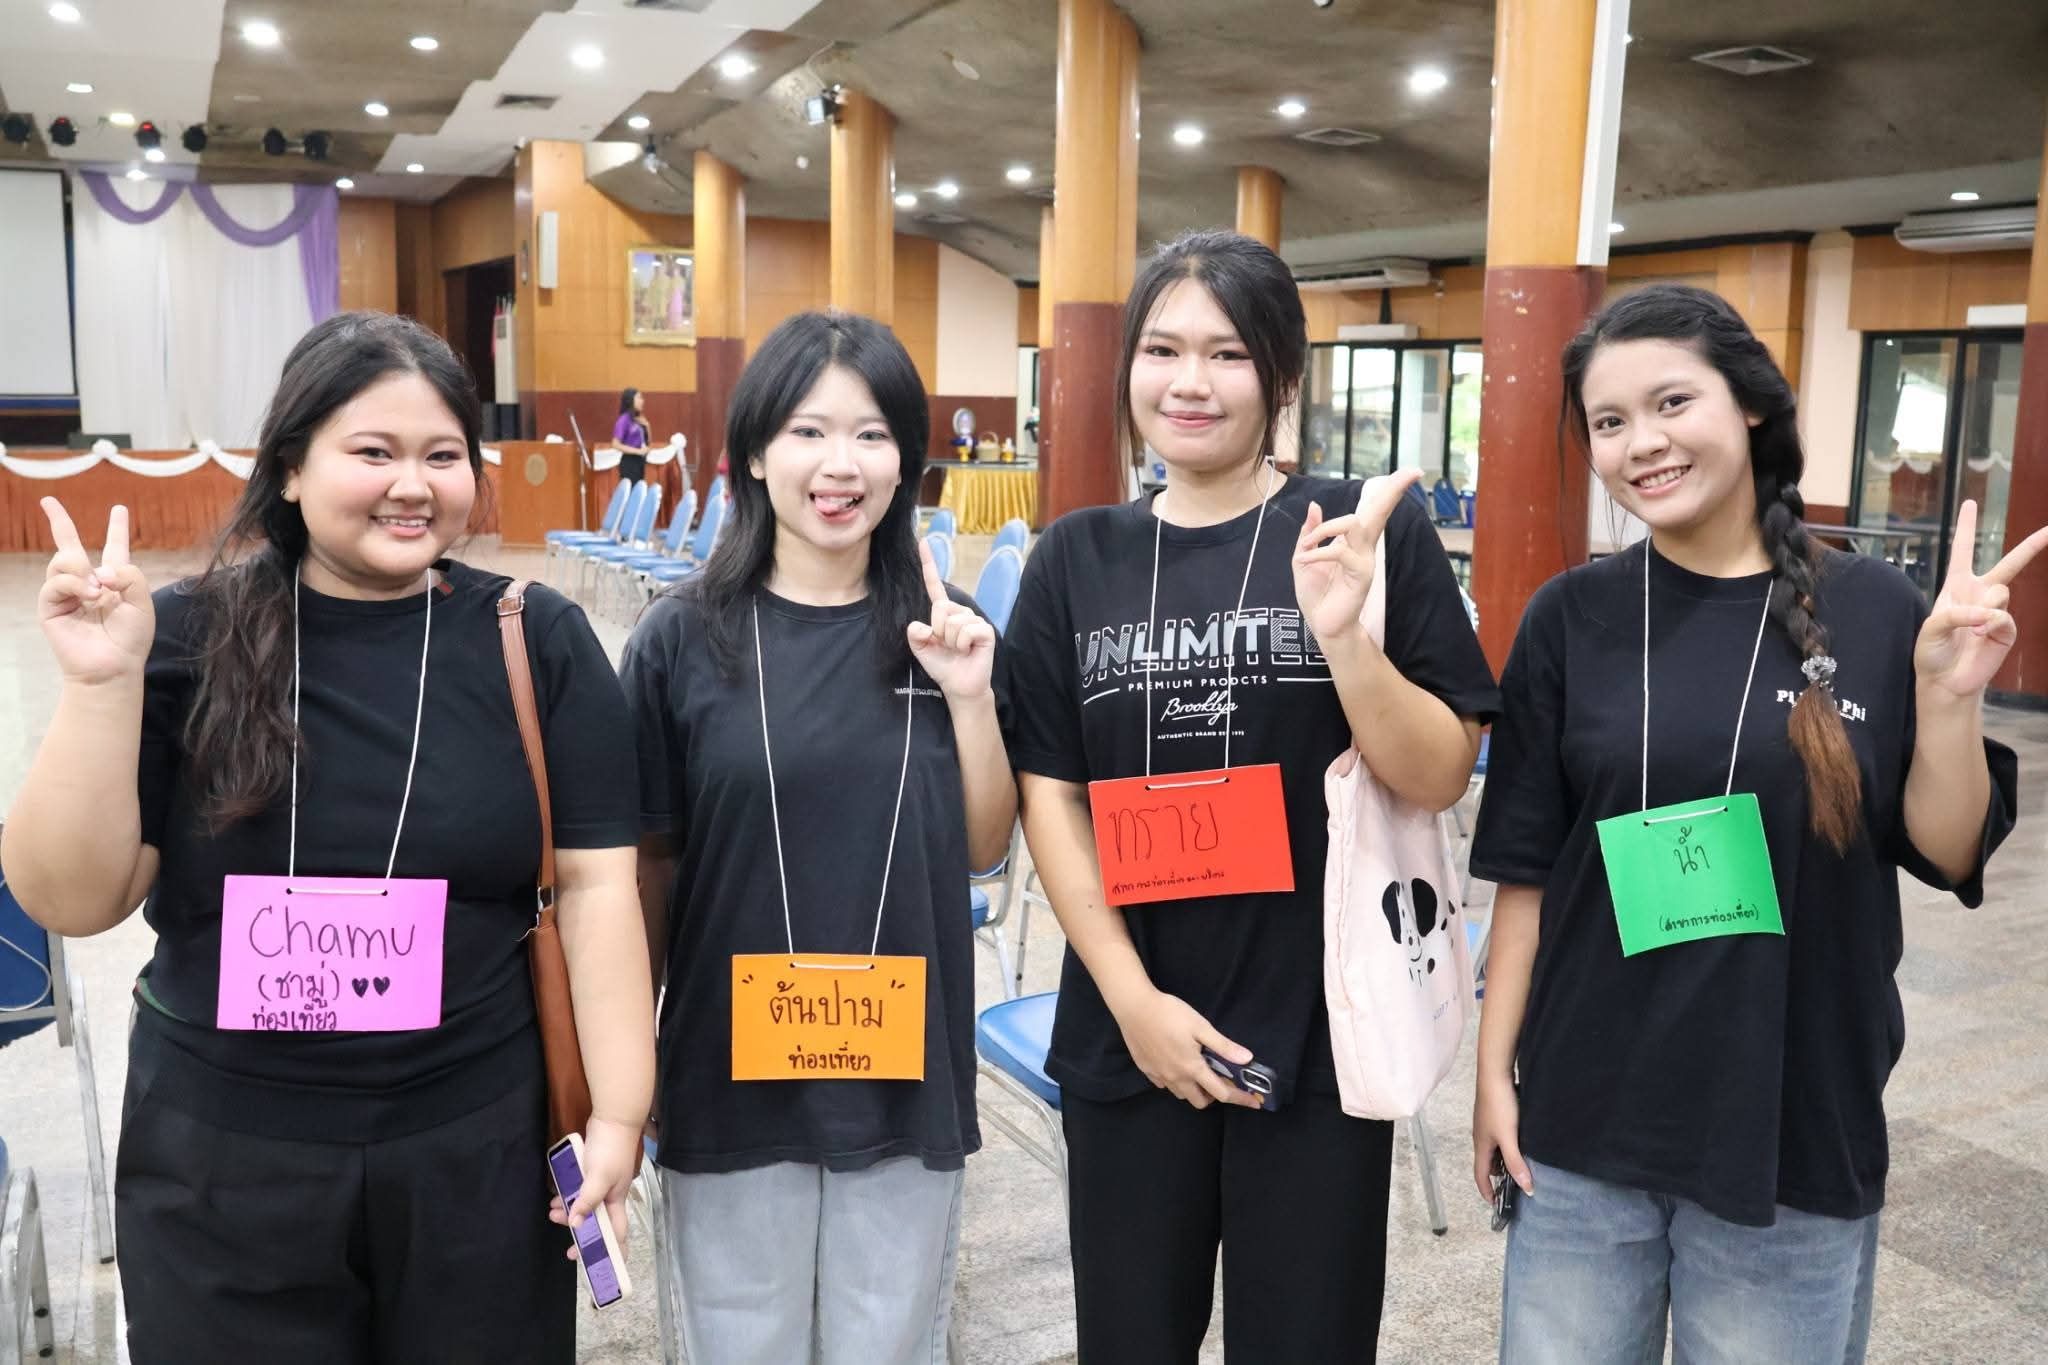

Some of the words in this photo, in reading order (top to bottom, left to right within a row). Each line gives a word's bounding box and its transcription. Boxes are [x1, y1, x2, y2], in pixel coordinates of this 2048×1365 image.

[1128, 678, 1193, 692] PREMIUM
[1160, 690, 1238, 726] Brooklyn
[1841, 699, 1866, 722] Phi
[1157, 731, 1193, 740] AUTHENTIC
[1674, 825, 1710, 875] น้ำ
[249, 905, 415, 958] Chamu
[788, 1041, 871, 1071] ท่องเที่ยว
